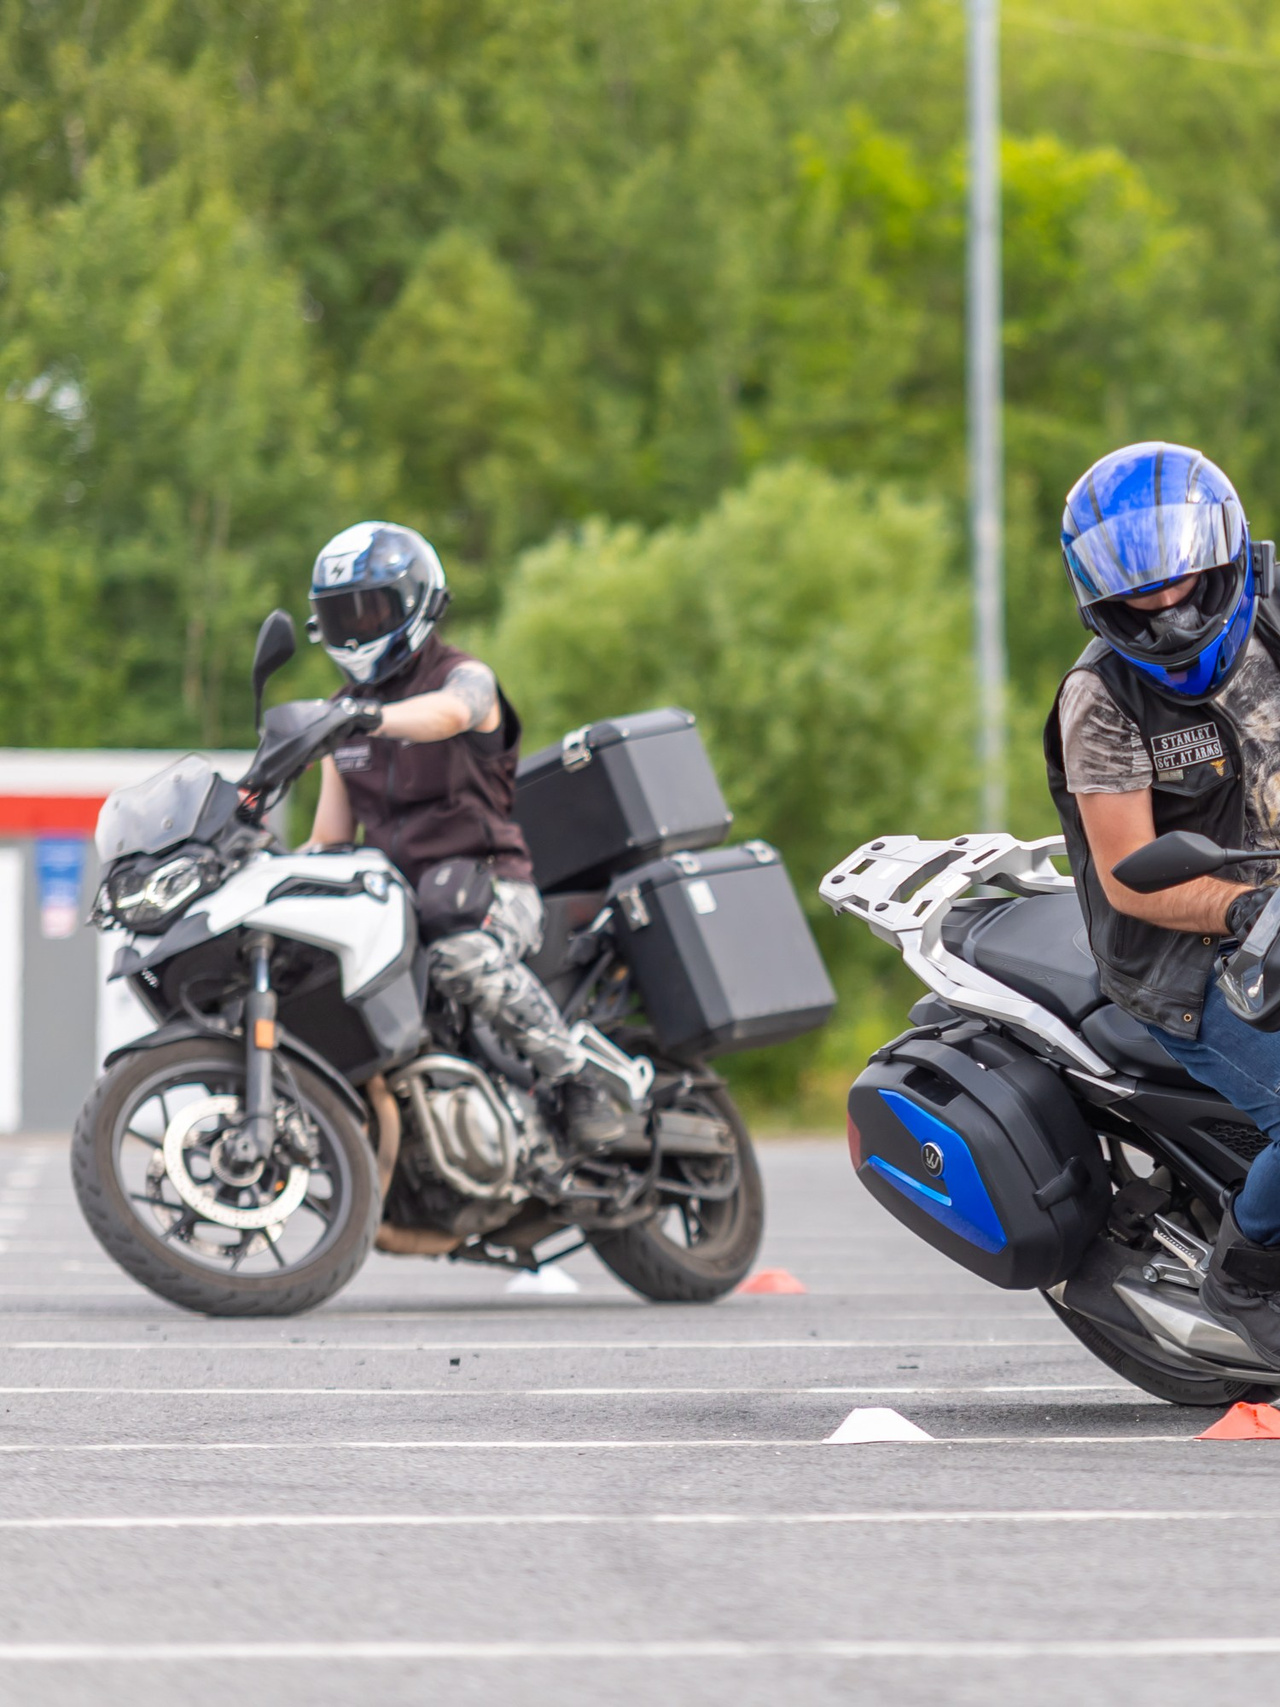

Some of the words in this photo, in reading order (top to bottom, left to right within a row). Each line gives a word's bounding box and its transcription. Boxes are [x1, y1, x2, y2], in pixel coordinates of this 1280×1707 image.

[1161, 726, 1211, 749] STANLEY
[1157, 754, 1179, 769] SGT.
[1181, 751, 1193, 767] AT
[1195, 743, 1220, 760] ARMS
